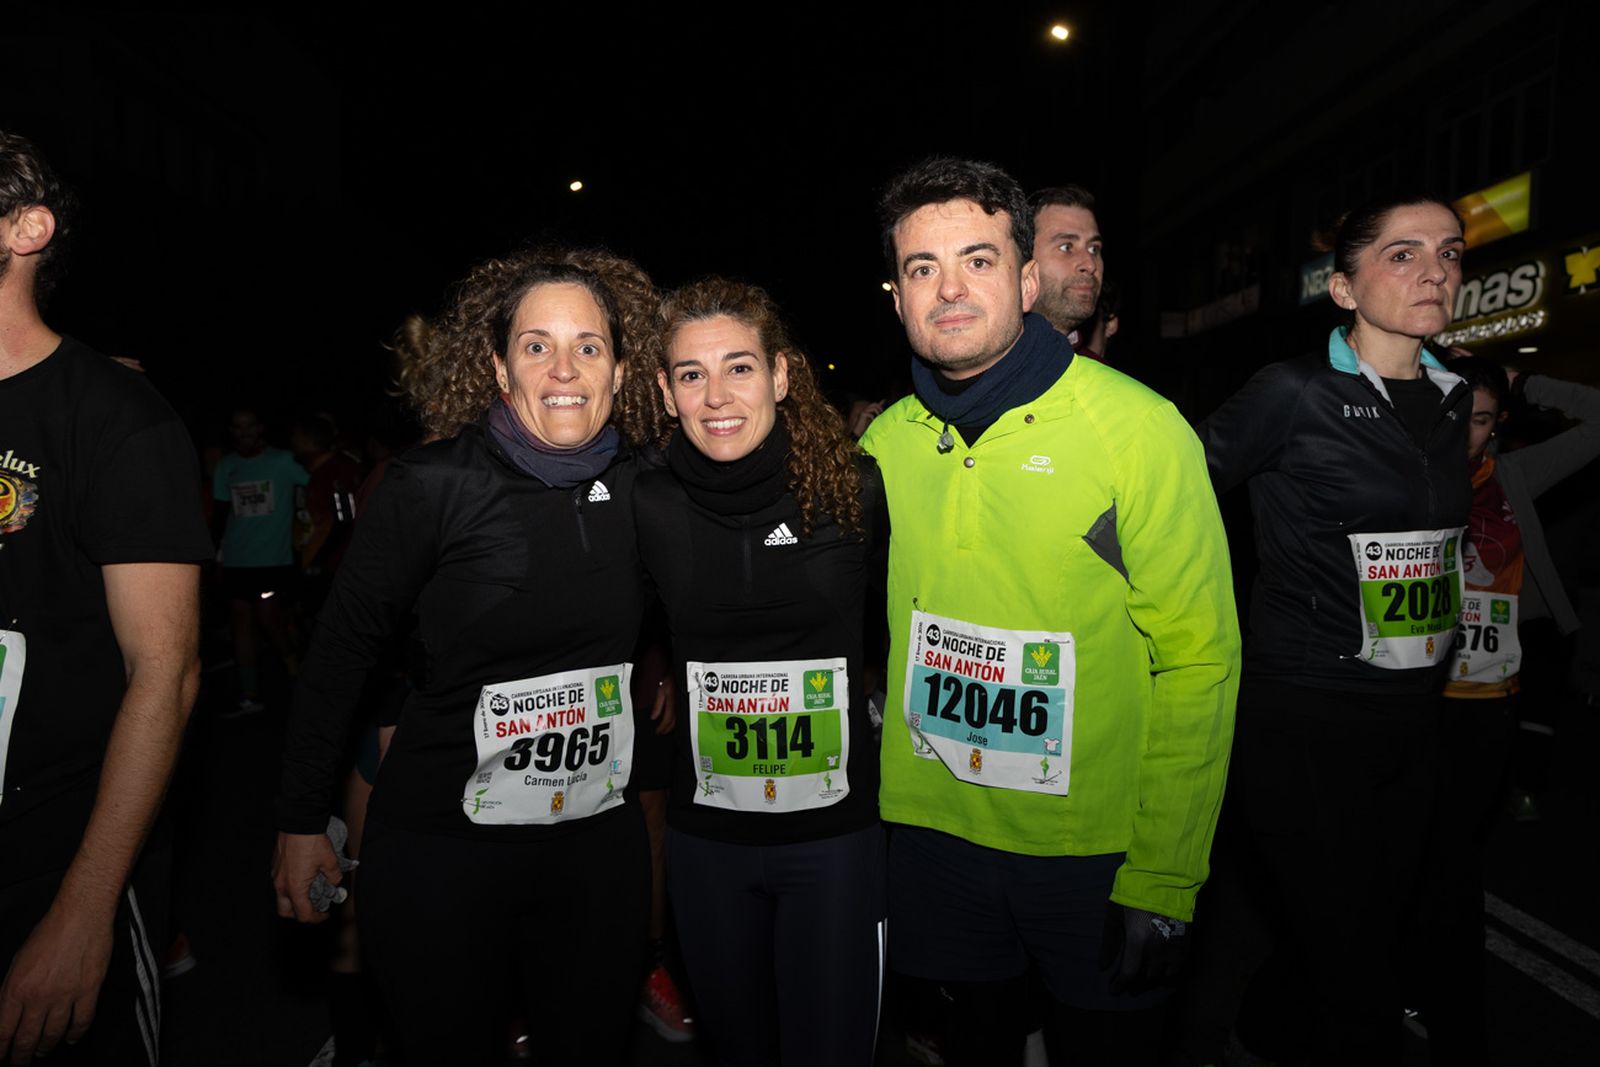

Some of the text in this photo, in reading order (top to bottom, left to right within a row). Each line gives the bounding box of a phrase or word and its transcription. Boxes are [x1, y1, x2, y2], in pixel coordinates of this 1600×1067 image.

[764, 535, 798, 546] adidas
[1366, 545, 1381, 557] 43
[1385, 547, 1430, 561] NOCHE
[1368, 565, 1399, 580] SAN
[1381, 577, 1451, 622] 2028
[1468, 601, 1481, 610] DE
[1461, 611, 1481, 622] TÓN
[926, 628, 940, 641] 43
[1411, 624, 1425, 634] Eva
[1456, 625, 1498, 652] 676
[941, 636, 1006, 662] NOCHE DE
[924, 650, 1005, 683] SAN ANTÓN
[705, 675, 718, 687] 43
[721, 678, 789, 694] NOCHE DE
[491, 699, 508, 711] 43
[513, 688, 584, 714] NOCHE DE
[707, 693, 789, 713] SAN ANTÓN
[924, 672, 1049, 737] 12046
[496, 718, 531, 738] SAN
[725, 714, 815, 760] 3114
[966, 731, 988, 747] Jose
[504, 722, 610, 773] 3965
[752, 763, 786, 775] FELIPE
[524, 771, 588, 787] Carmen Lucía
